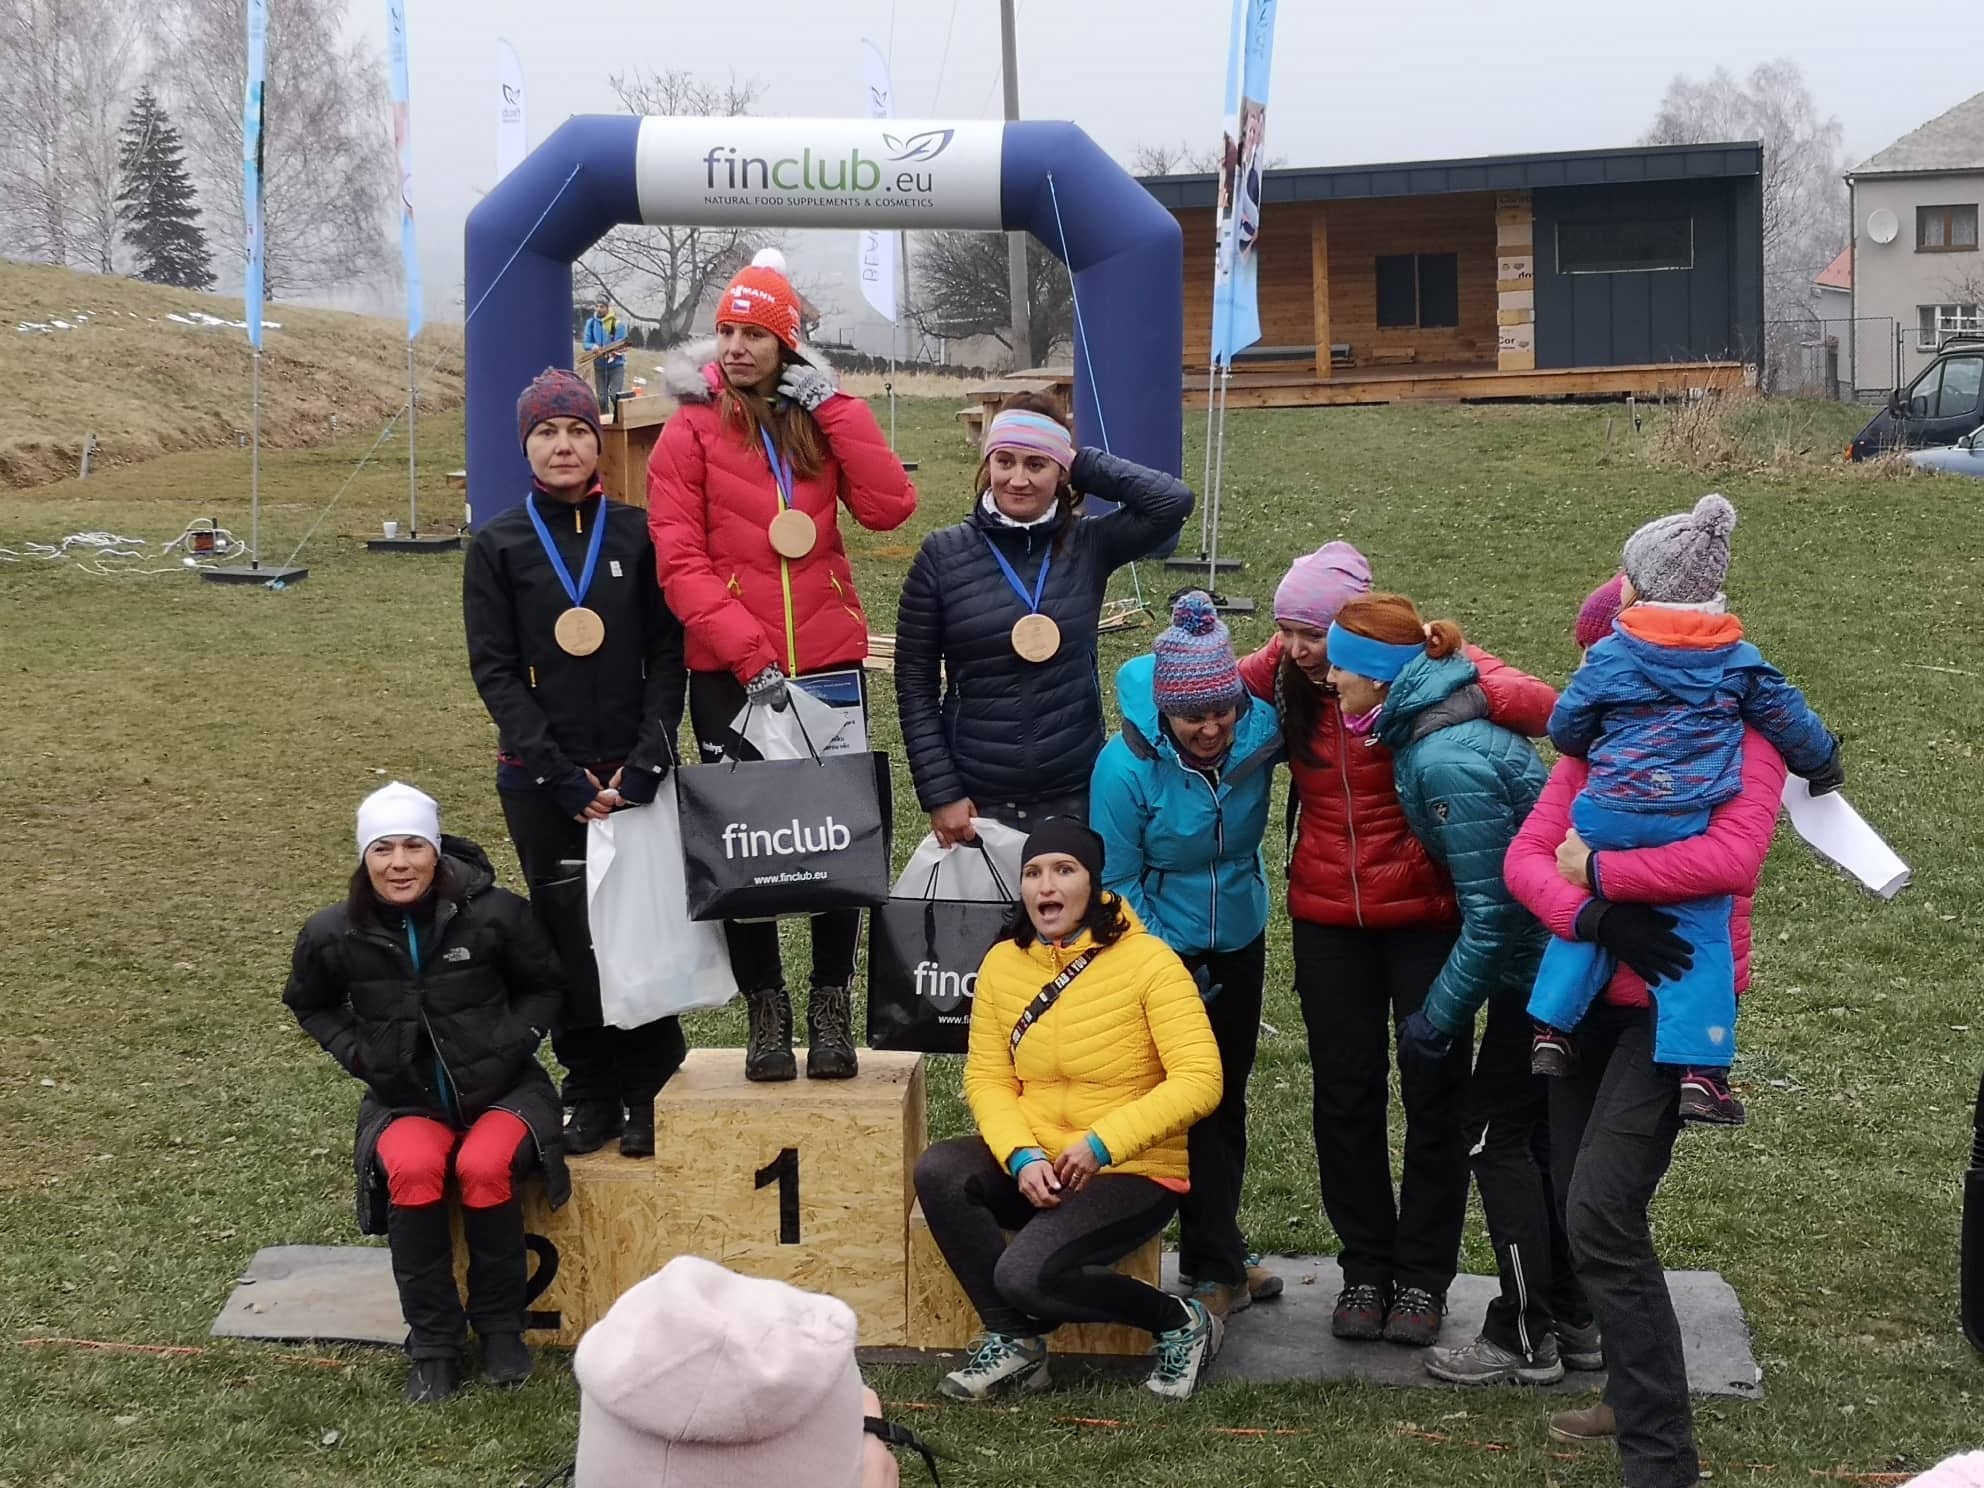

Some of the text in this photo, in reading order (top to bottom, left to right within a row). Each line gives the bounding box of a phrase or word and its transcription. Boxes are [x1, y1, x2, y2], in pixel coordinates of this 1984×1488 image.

[704, 196, 934, 208] NATURAL FOOD SUPPLEMENTS & COSMETICS
[722, 816, 851, 859] finclub
[754, 871, 828, 885] www.finclub.eu
[1071, 956, 1088, 972] YOU
[755, 1147, 800, 1244] 1
[524, 1233, 561, 1329] 2
